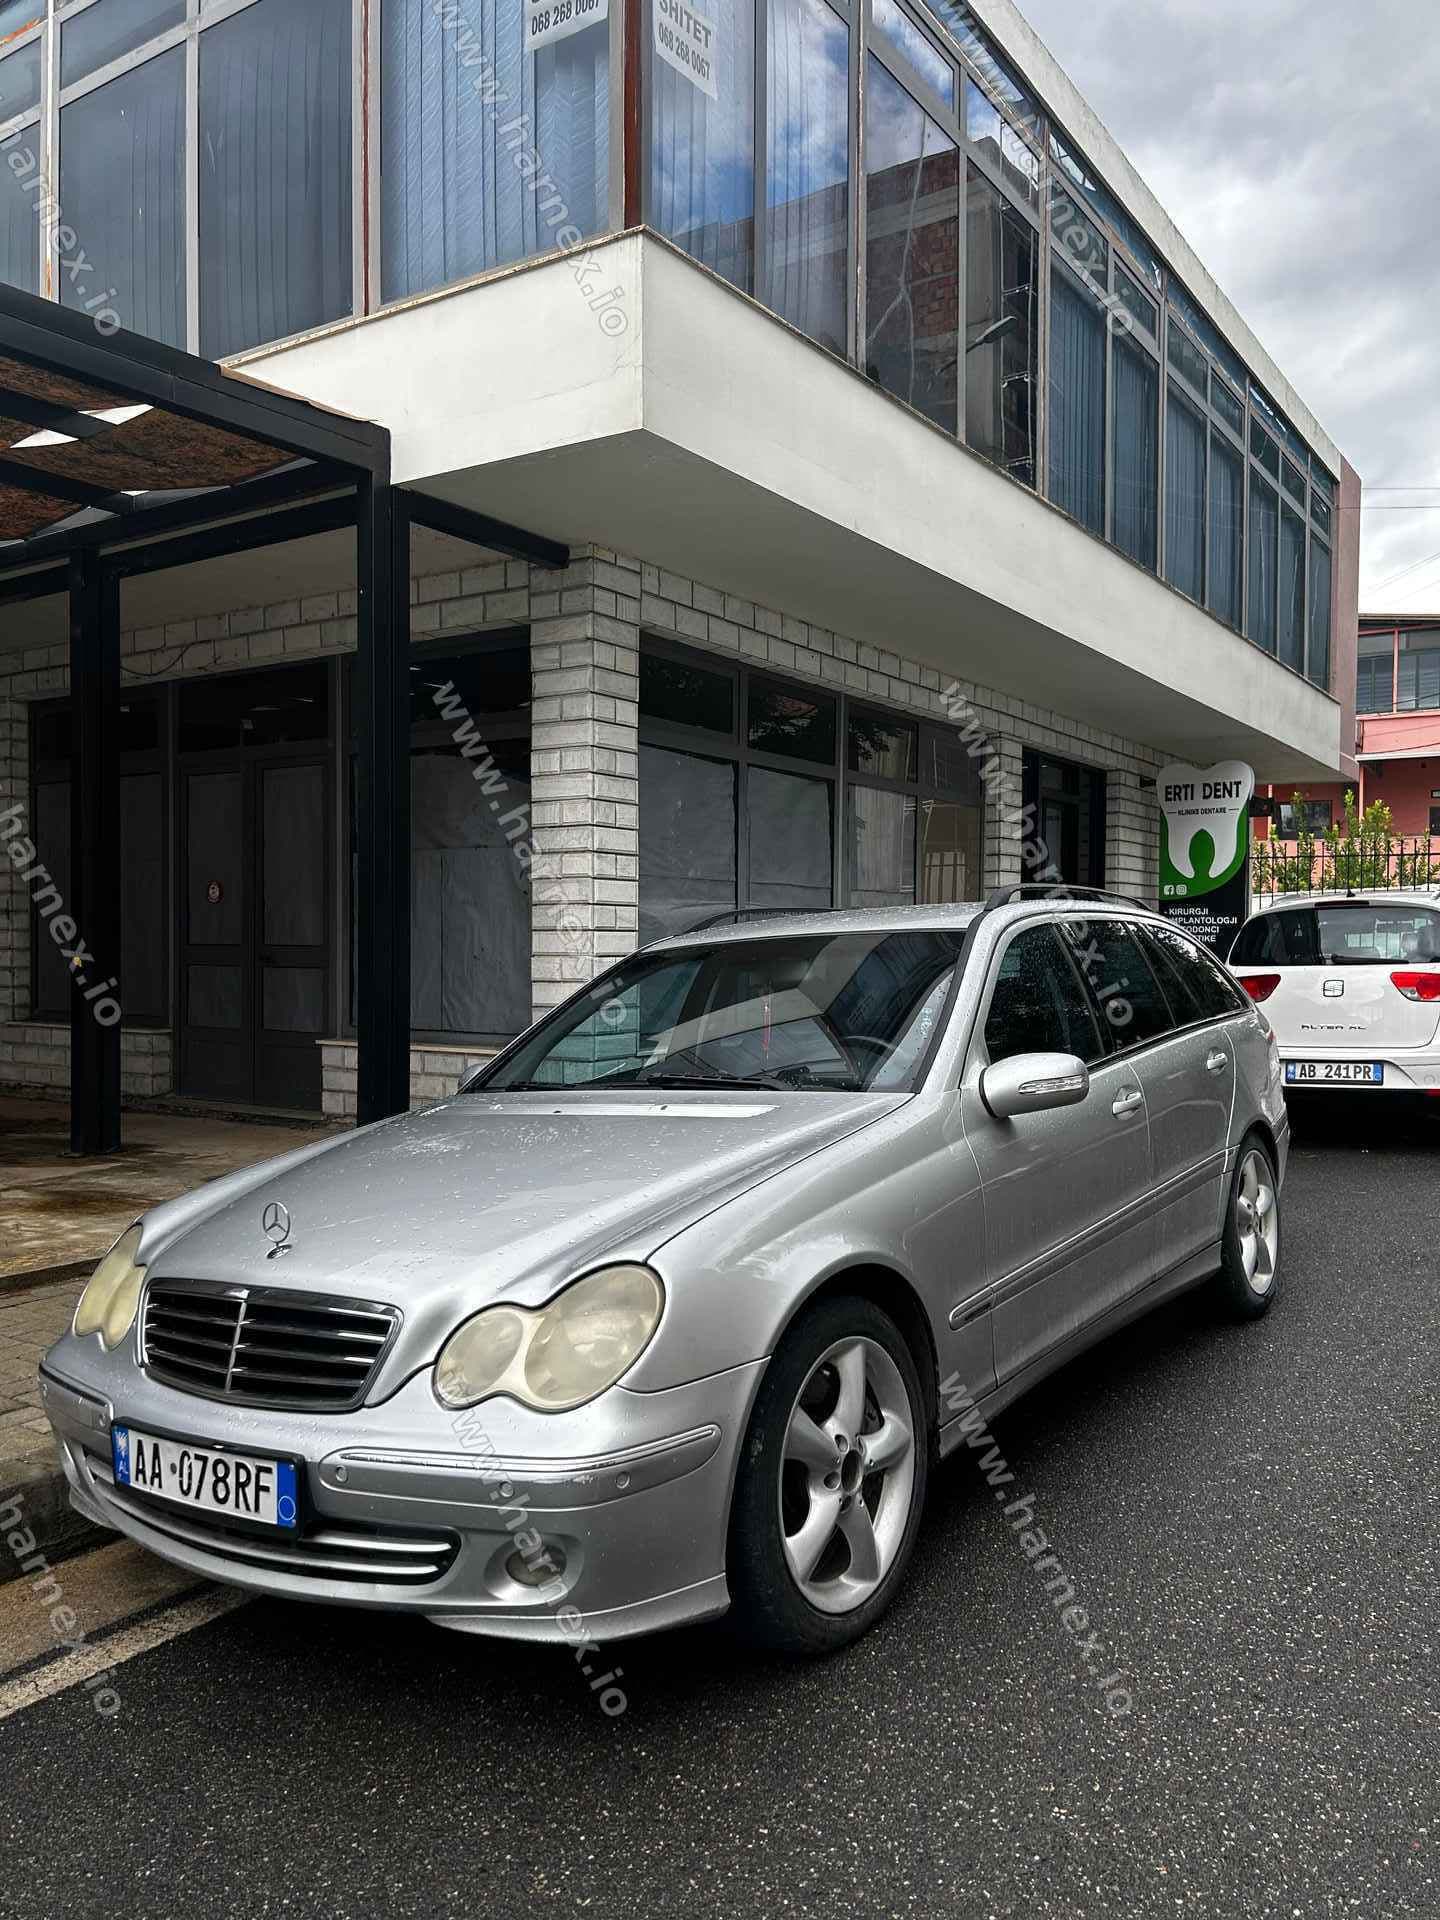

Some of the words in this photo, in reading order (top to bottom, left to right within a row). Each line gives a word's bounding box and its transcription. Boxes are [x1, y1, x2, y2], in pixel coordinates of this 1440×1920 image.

[532, 10, 550, 35] 068
[553, 1, 572, 26] 268
[659, 22, 673, 51] 068
[675, 36, 689, 64] 268
[691, 50, 710, 80] 0067
[1165, 784, 1194, 801] ERTI
[1202, 781, 1241, 799] DENT
[1169, 908, 1209, 916] KIRURGJI
[1299, 1064, 1316, 1078] AB
[135, 1439, 162, 1489] AA
